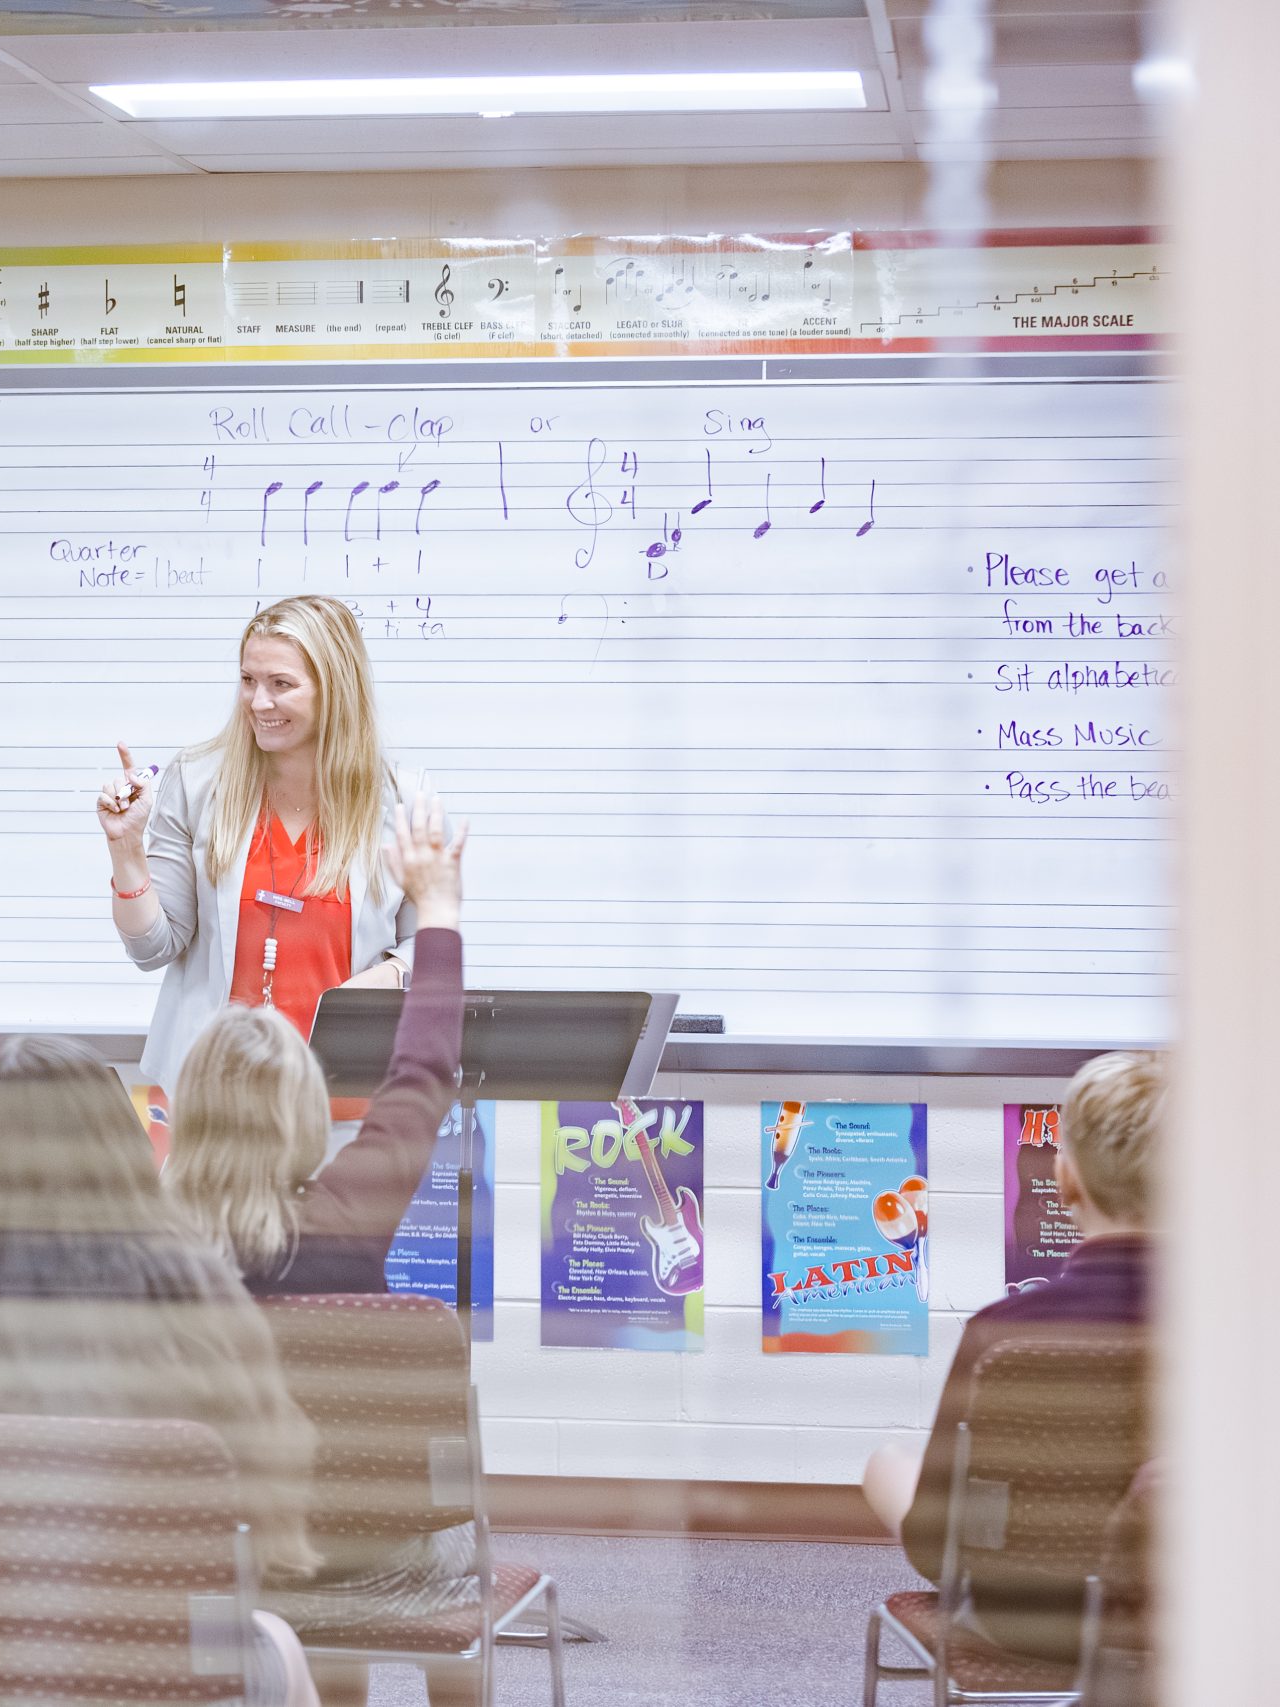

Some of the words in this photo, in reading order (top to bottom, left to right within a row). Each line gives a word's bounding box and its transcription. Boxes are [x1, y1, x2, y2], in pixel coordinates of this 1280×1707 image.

[422, 322, 451, 331] TREBLE
[455, 321, 474, 330] CLEF
[480, 322, 503, 330] BASS
[617, 320, 647, 329] LEGATO
[662, 320, 683, 328] SLUR
[803, 318, 837, 326] ACCENT
[1013, 316, 1038, 328] THE
[1042, 315, 1088, 328] MAJOR
[1093, 314, 1134, 327] SCALE
[31, 328, 59, 337] SHARP
[101, 328, 119, 336] FLAT
[166, 327, 203, 335] NATURAL
[237, 325, 261, 333] STAFF
[275, 325, 316, 333] MEASURE
[326, 324, 342, 334] (the
[344, 324, 362, 333] end)
[375, 323, 407, 333] (repeat)
[799, 327, 823, 336] louder
[81, 337, 97, 346] (half
[99, 338, 114, 346] step
[115, 337, 139, 345] lower)
[147, 336, 175, 345] (cancel
[176, 336, 196, 345] sharp
[207, 335, 222, 344] flat)
[434, 332, 442, 341] (G
[444, 332, 461, 341] clef)
[15, 338, 32, 347] (half
[33, 338, 48, 347] step
[50, 337, 75, 347] higher)
[209, 406, 270, 441] Roll
[530, 414, 560, 433] or
[704, 409, 772, 454] Sing
[204, 454, 216, 481] 4
[620, 451, 638, 479] 4
[620, 485, 636, 520] 4
[50, 539, 148, 563] Quarter
[167, 556, 213, 589] beat
[648, 561, 669, 580] D
[985, 552, 1070, 587] Please
[1095, 560, 1144, 604] get
[1152, 570, 1169, 588] a
[1002, 598, 1053, 635] from
[1062, 611, 1103, 638] the
[1116, 613, 1177, 638] back
[995, 663, 1033, 692] Sit
[998, 720, 1063, 749] Mass
[1074, 721, 1163, 747] Music
[1006, 770, 1070, 804] Pass
[1077, 773, 1118, 800] the
[835, 1122, 847, 1130] The
[849, 1122, 870, 1130] Sound:
[554, 1104, 695, 1176] ROCK
[803, 1170, 816, 1178] The
[594, 1177, 606, 1185] The
[607, 1177, 629, 1185] Sound:
[793, 1236, 805, 1244] The
[569, 1259, 580, 1267] The
[582, 1259, 605, 1268] Places:
[767, 1248, 916, 1296] LATIN
[594, 1275, 604, 1283] City
[558, 1286, 570, 1294] The
[772, 1271, 916, 1309] American
